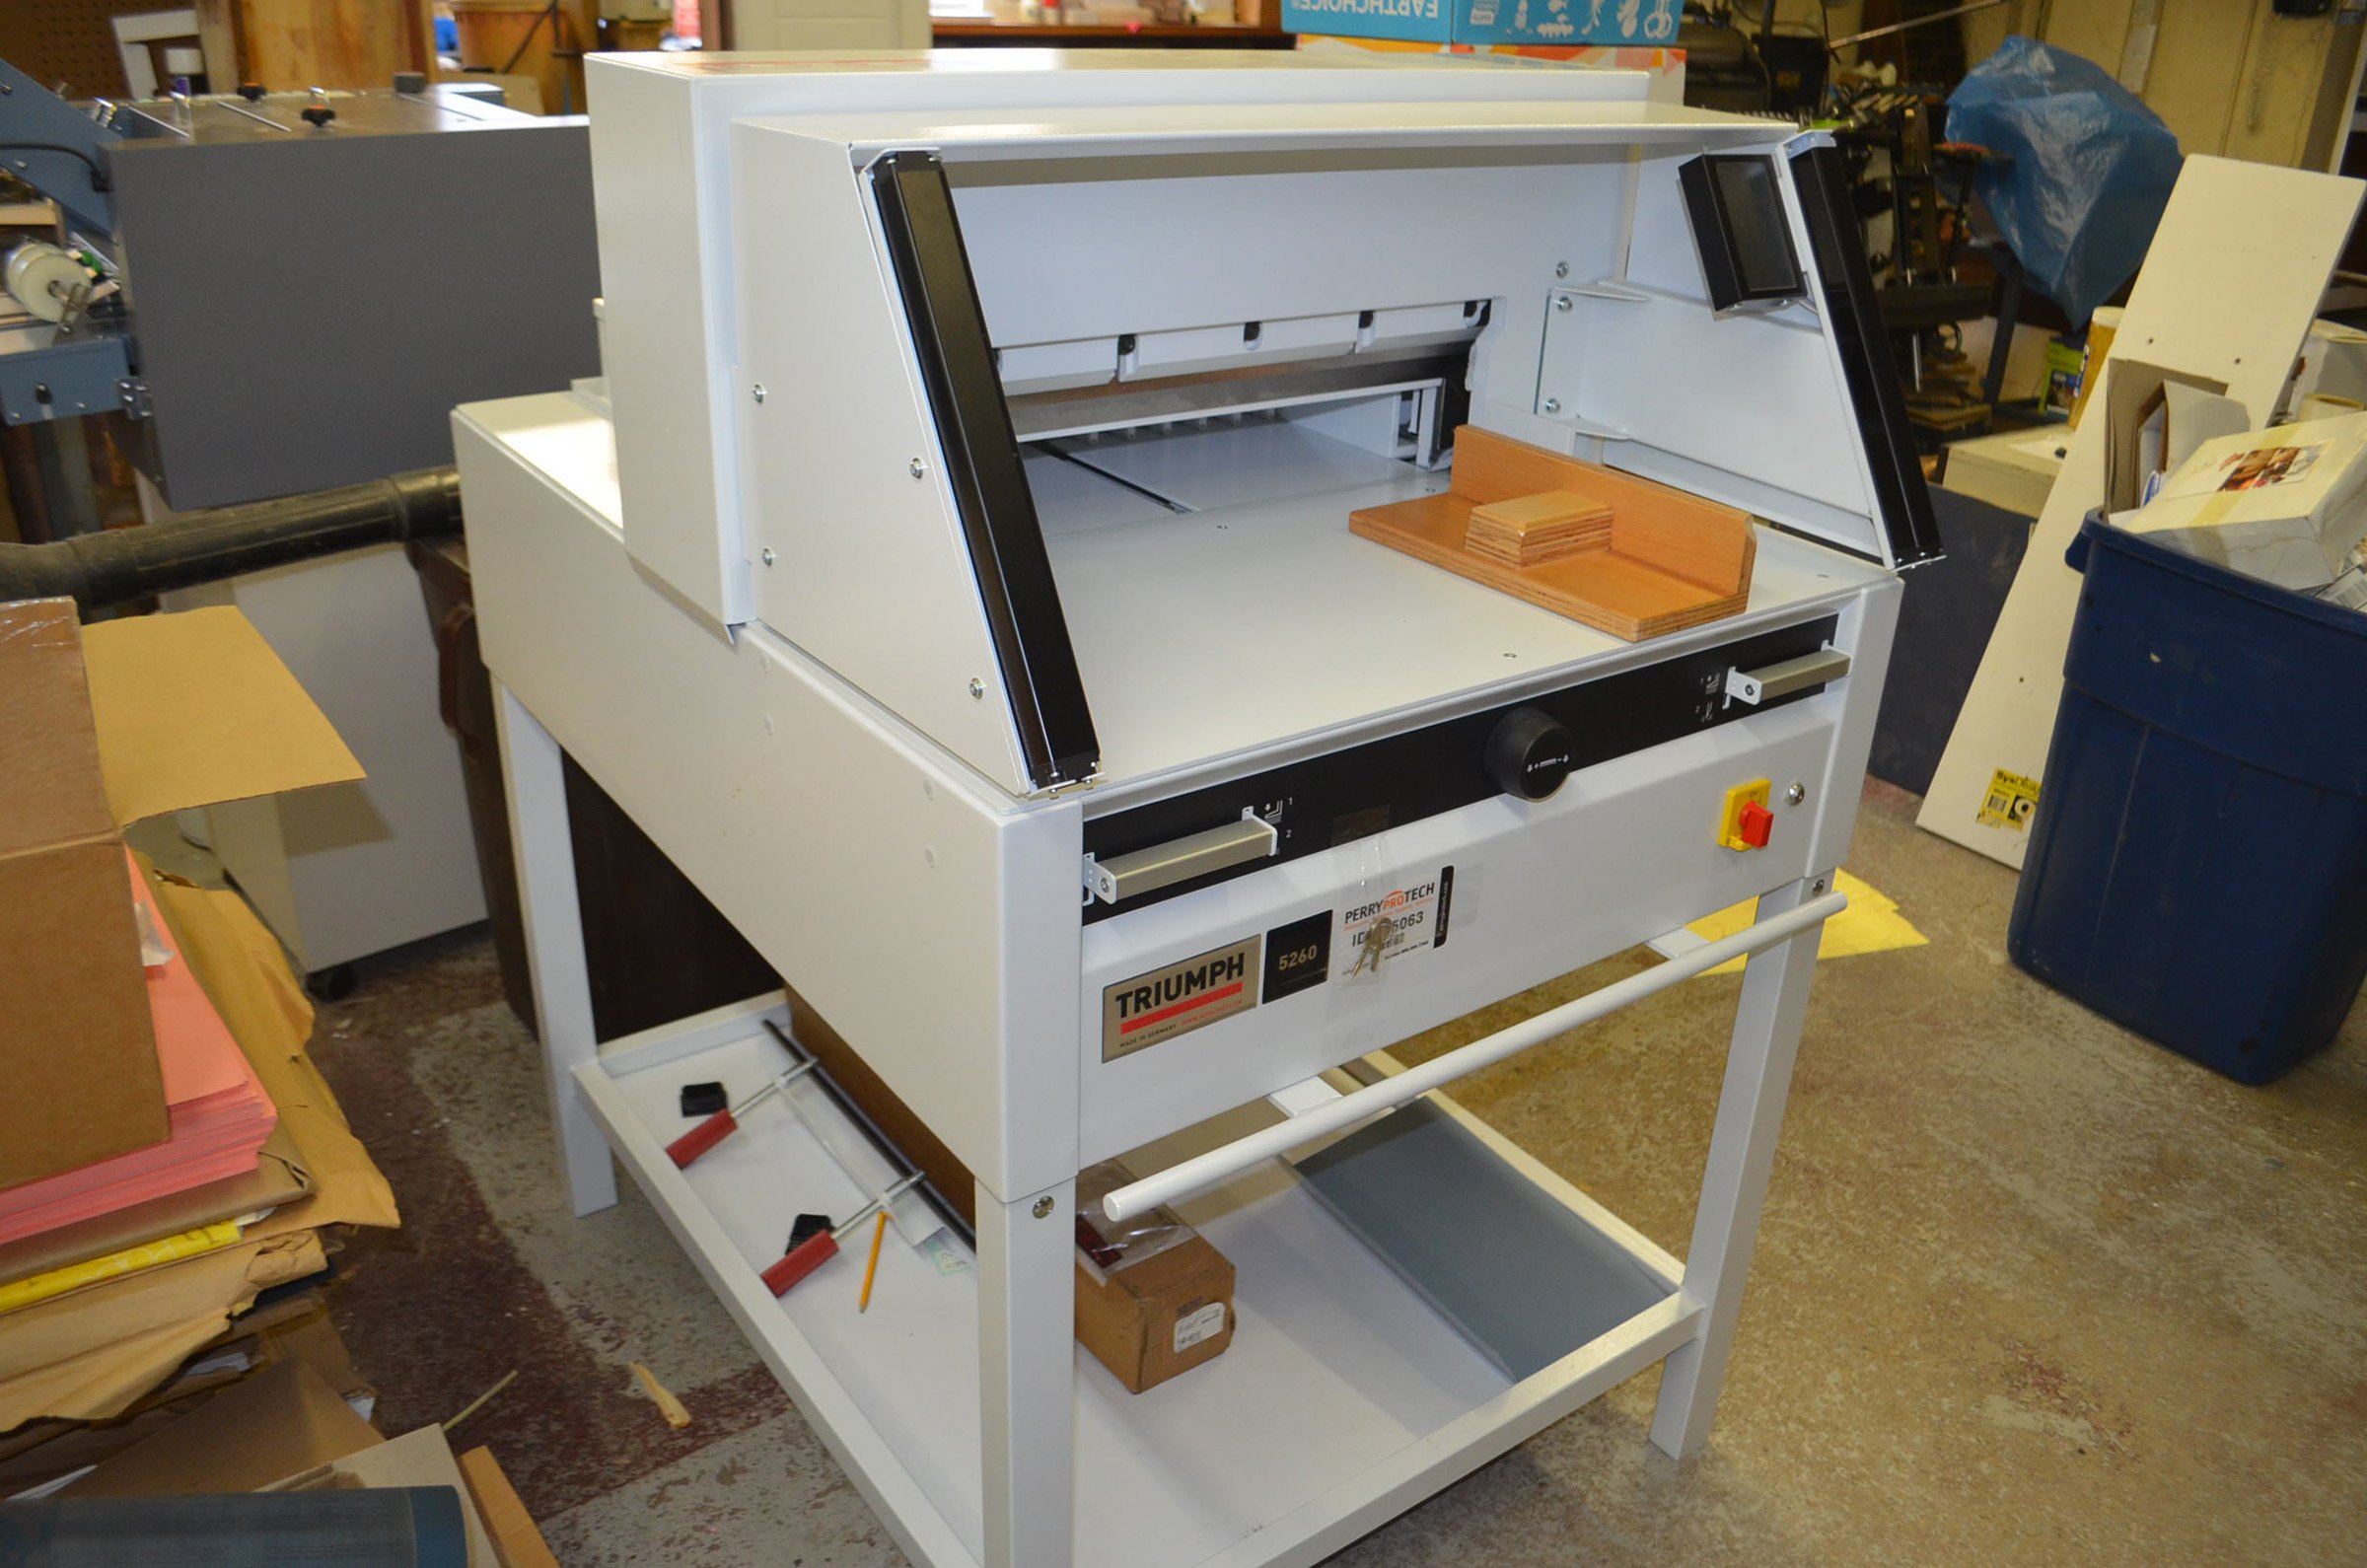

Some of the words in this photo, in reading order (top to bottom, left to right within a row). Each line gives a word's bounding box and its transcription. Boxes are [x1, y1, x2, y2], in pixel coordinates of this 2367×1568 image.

[1344, 883, 1435, 924] PERRYPROTECH
[1278, 945, 1318, 970] 5260
[1115, 952, 1245, 1019] TRIUMPH
